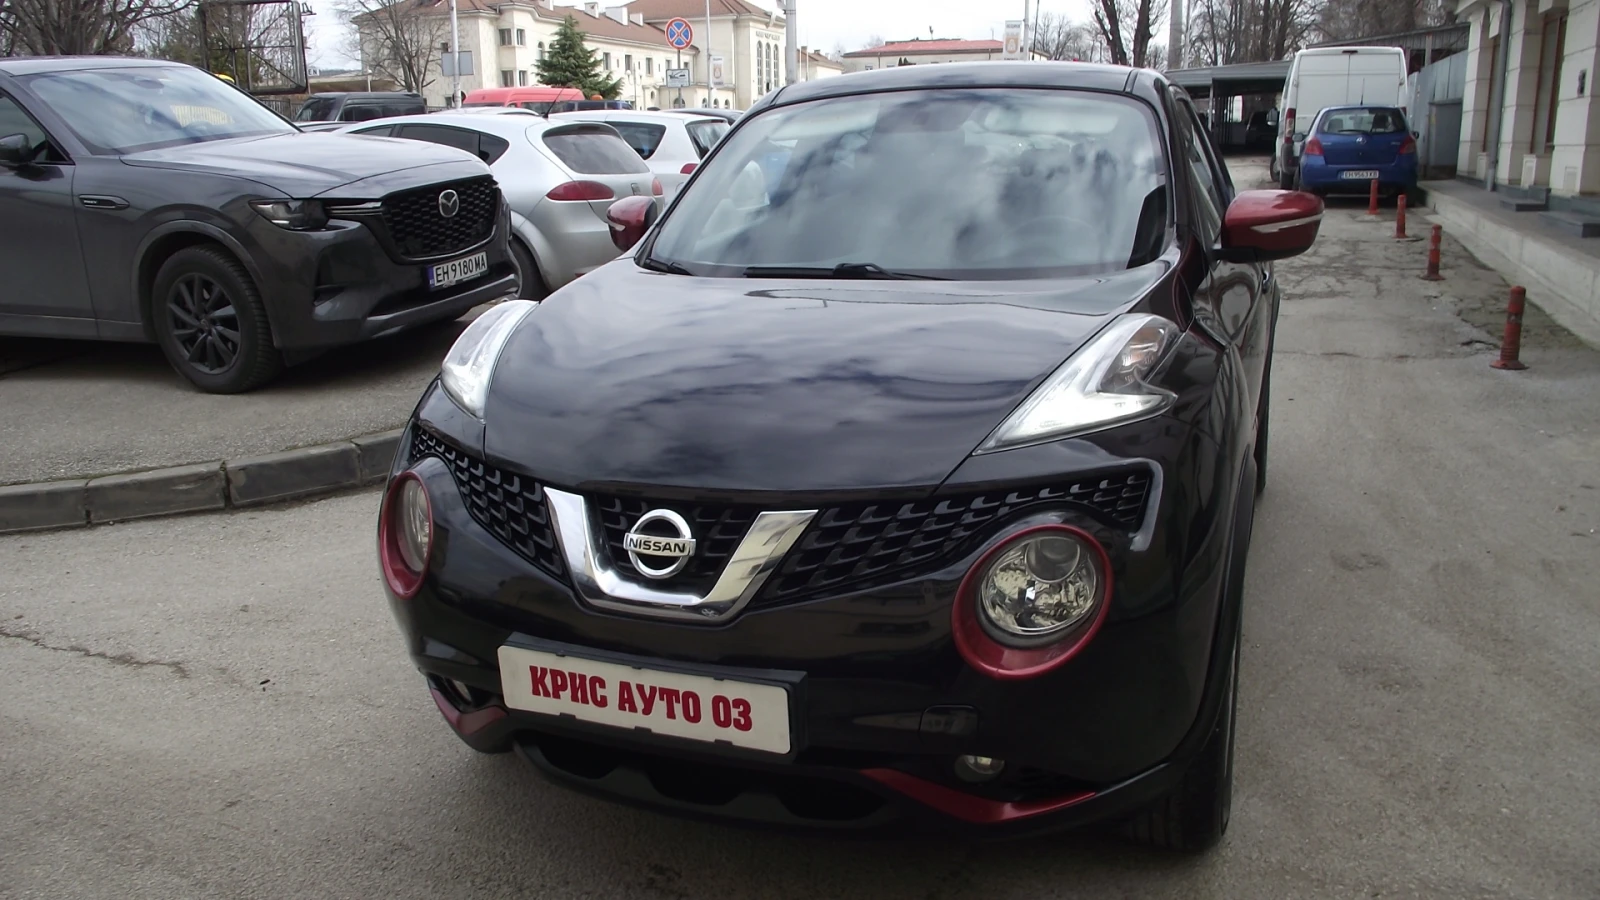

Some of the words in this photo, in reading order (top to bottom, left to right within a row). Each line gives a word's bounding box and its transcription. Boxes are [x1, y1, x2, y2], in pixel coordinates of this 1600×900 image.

[628, 537, 686, 553] NISSAN
[529, 665, 608, 709] КРИС
[618, 680, 702, 724] АУТО
[711, 694, 753, 732] 03
